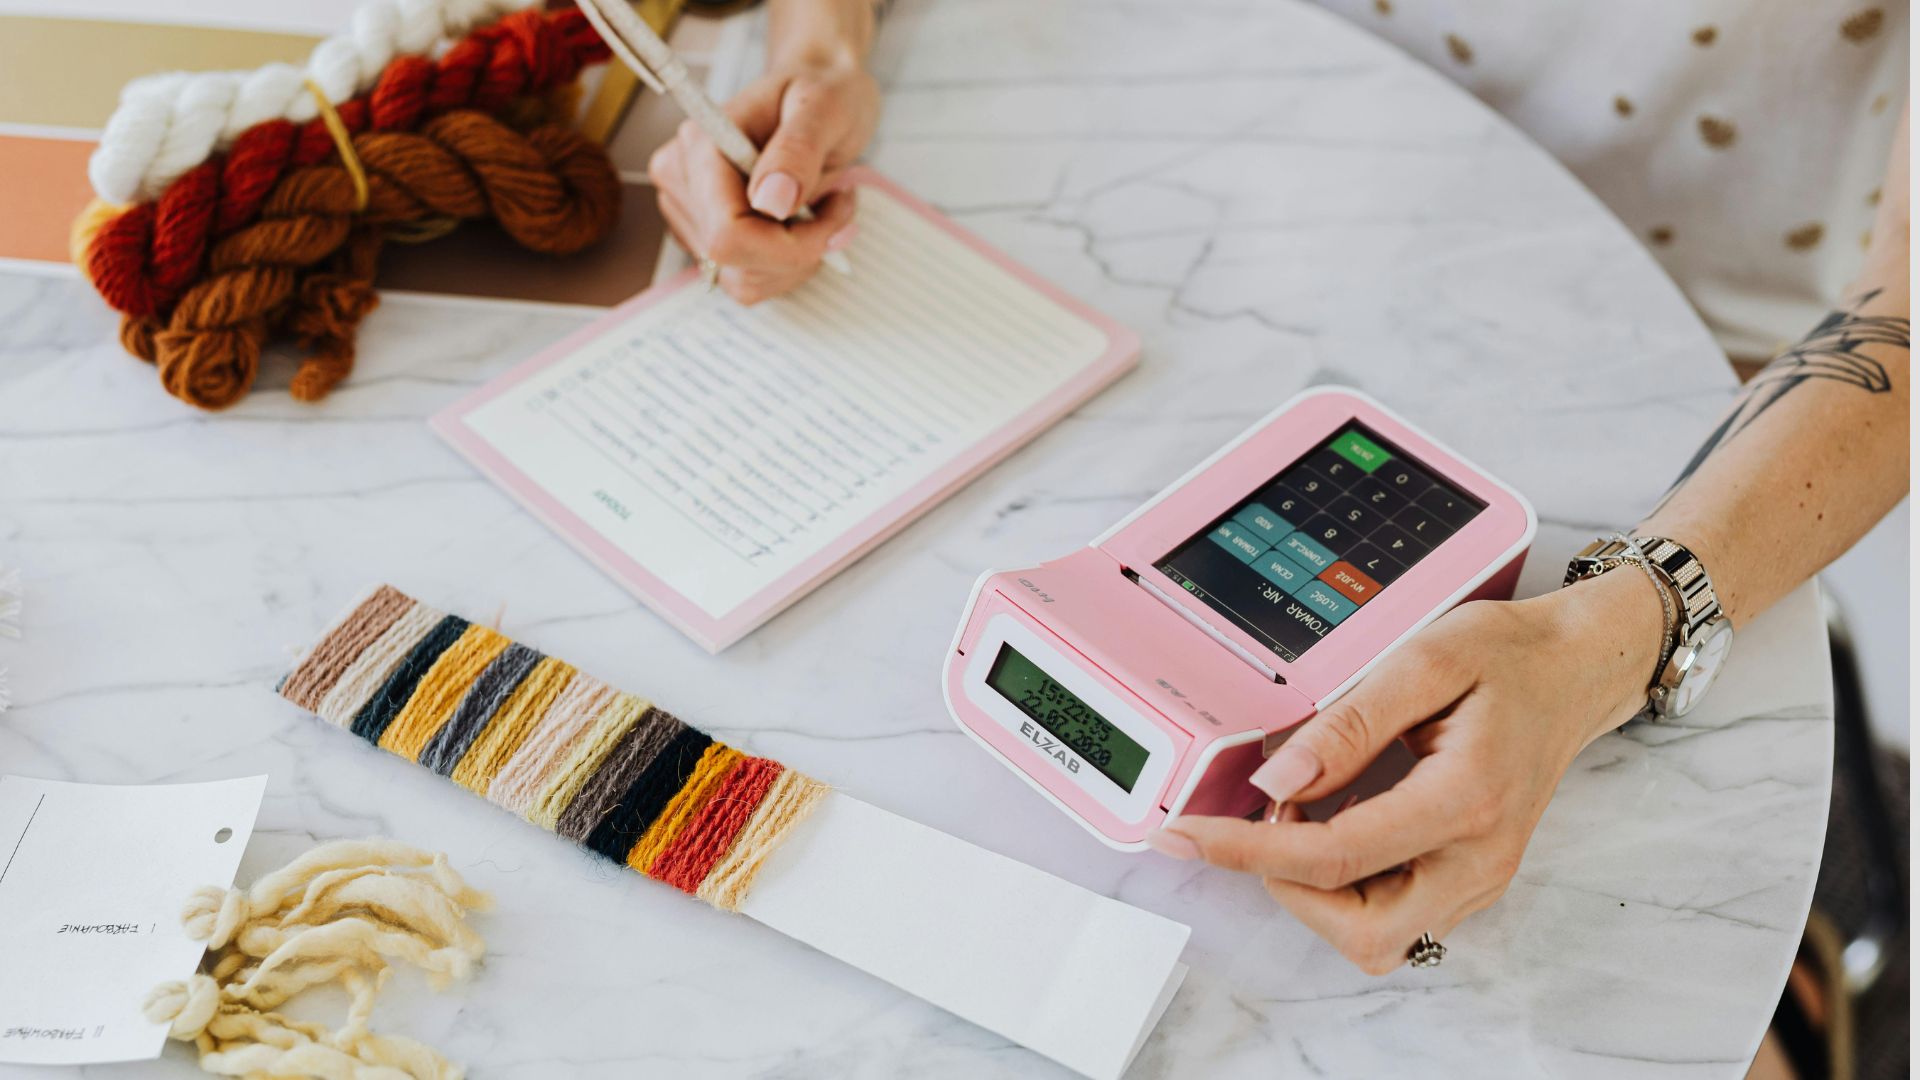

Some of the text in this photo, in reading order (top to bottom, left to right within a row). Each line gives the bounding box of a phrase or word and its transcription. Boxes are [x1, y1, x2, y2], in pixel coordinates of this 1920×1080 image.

[1329, 463, 1342, 474] 3
[1395, 474, 1409, 484] 0
[1305, 481, 1318, 492] 6
[1372, 492, 1386, 502] 2
[1281, 500, 1295, 510] 9
[1348, 509, 1362, 521] 5
[1416, 521, 1426, 531] 1
[1324, 528, 1337, 539] 8
[1219, 528, 1259, 556] TOWAR NR
[1392, 539, 1404, 548] 4
[1288, 539, 1326, 566] FUNKCJE
[1367, 559, 1379, 569] 7
[1271, 563, 1293, 579] CENA
[1258, 581, 1330, 636] TOWAR NR:
[1037, 678, 1113, 742] 15:22:35
[1019, 688, 1113, 767] 22.07.2020
[1019, 720, 1081, 775] ELZAB
[57, 922, 139, 934] FARBOWANIE
